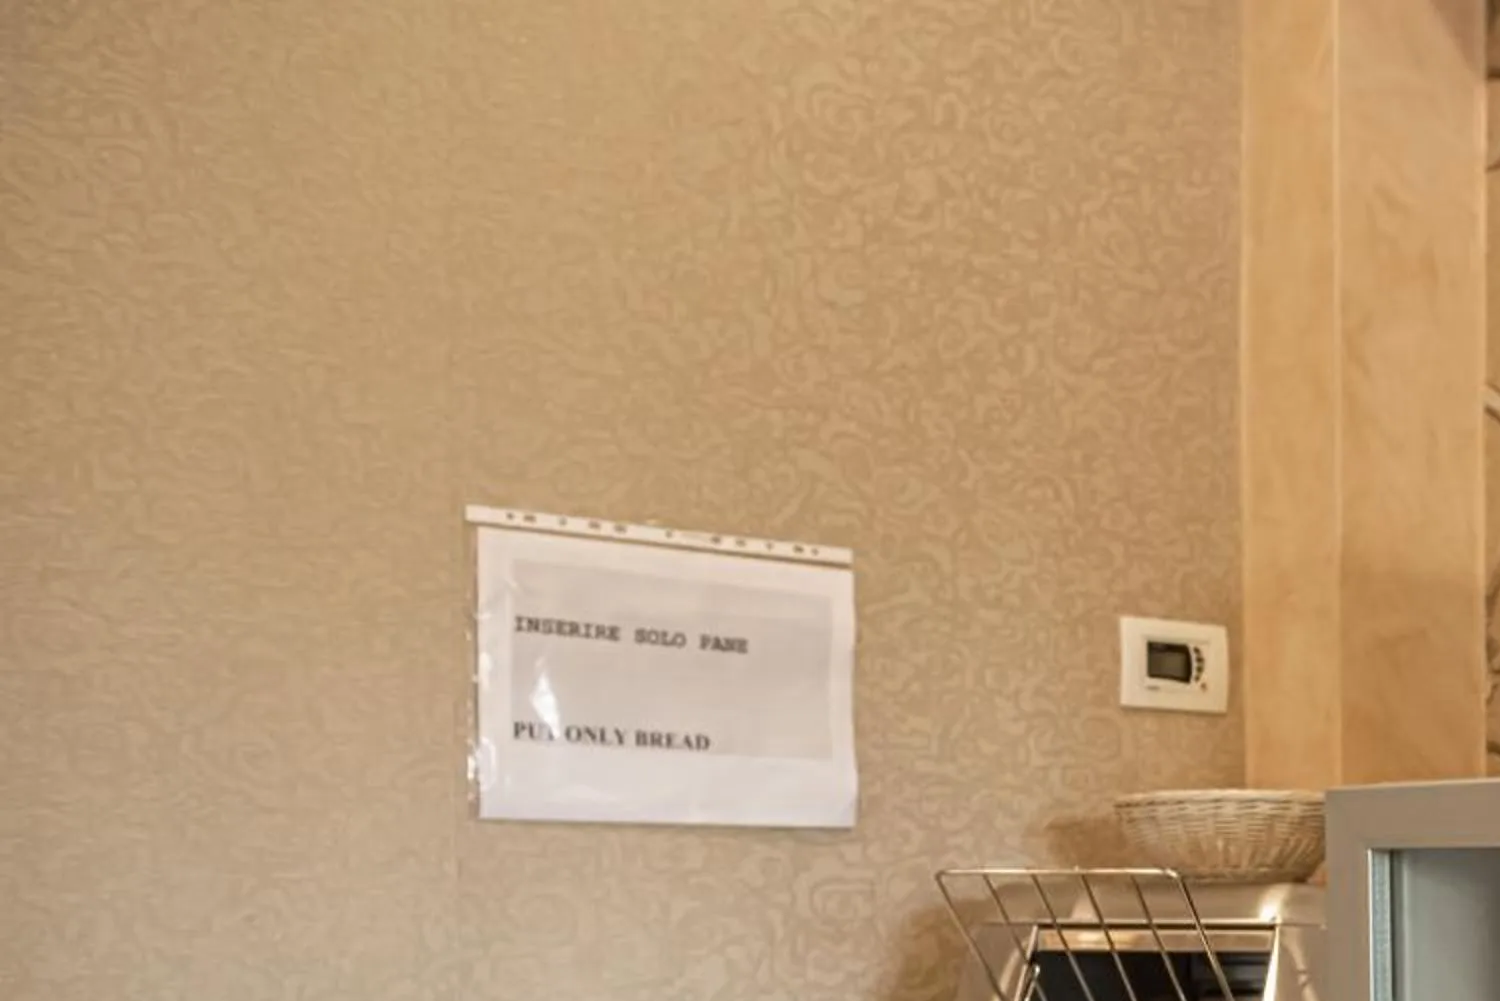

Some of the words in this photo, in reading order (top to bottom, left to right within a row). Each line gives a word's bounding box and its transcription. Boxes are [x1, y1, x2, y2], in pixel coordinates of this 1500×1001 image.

[514, 616, 621, 642] INSERIRE
[634, 629, 688, 649] SOLO
[699, 634, 749, 654] PANE
[564, 725, 625, 746] ONLY
[635, 729, 711, 751] BREAD
